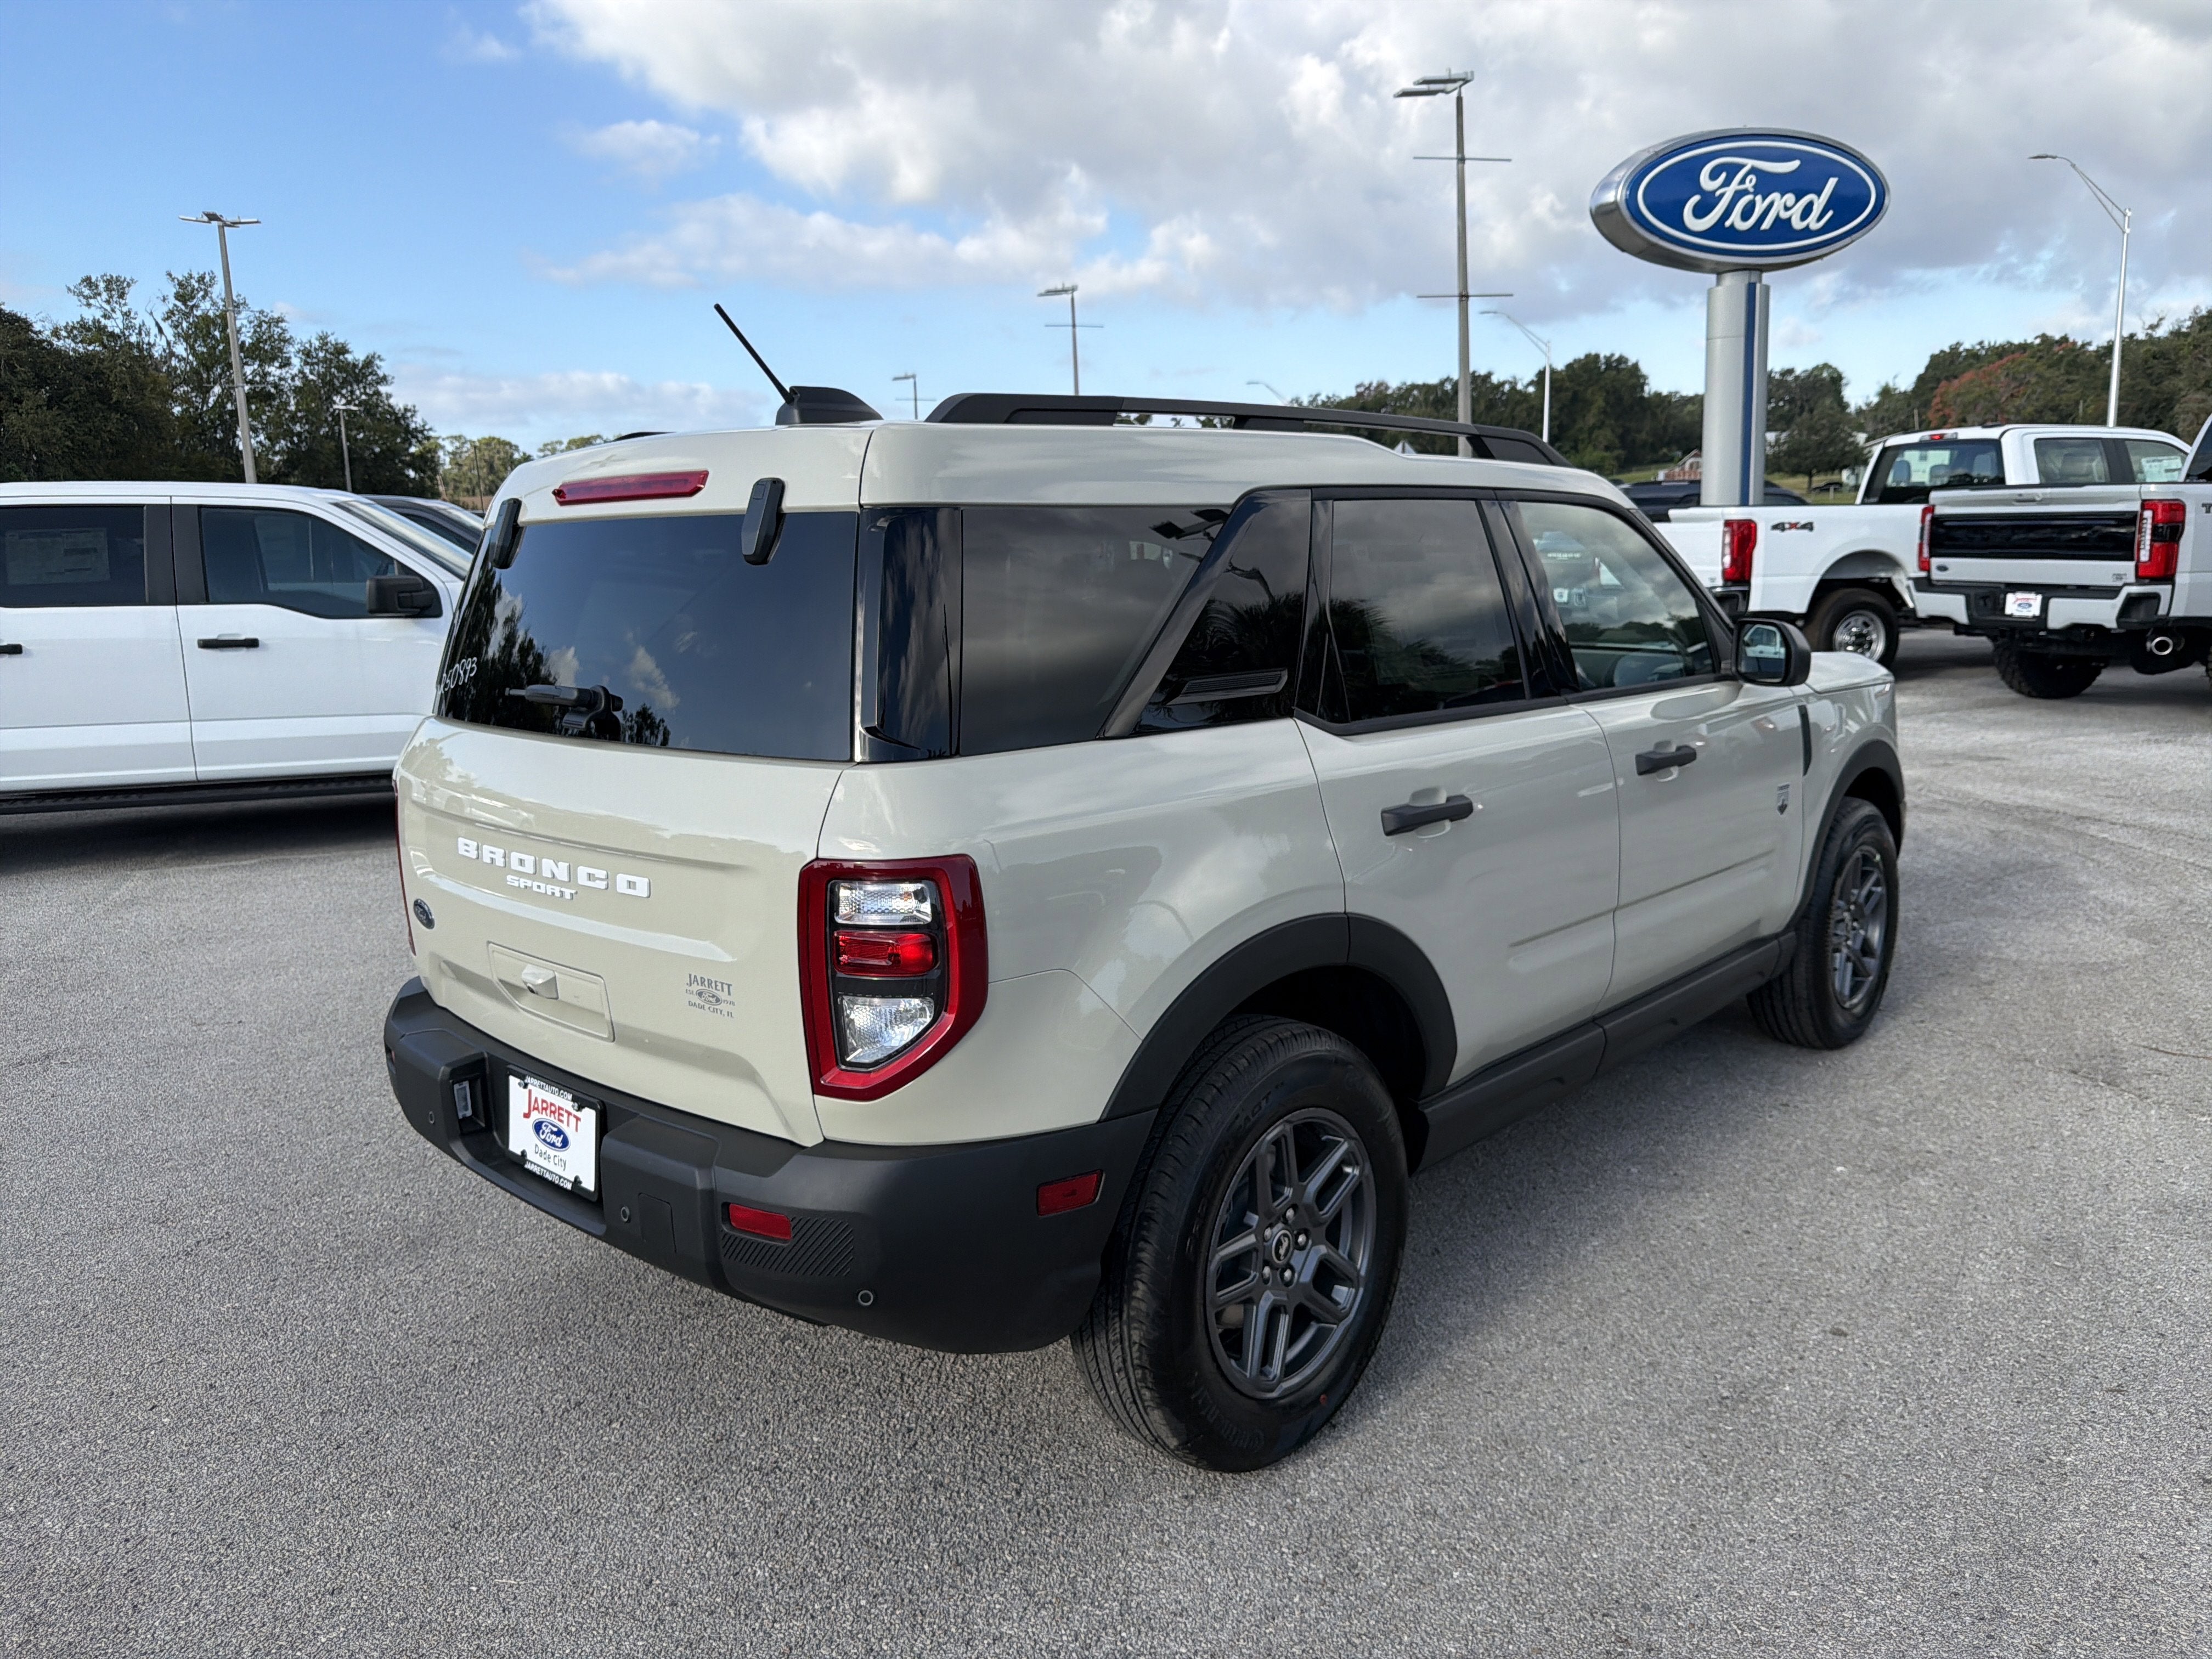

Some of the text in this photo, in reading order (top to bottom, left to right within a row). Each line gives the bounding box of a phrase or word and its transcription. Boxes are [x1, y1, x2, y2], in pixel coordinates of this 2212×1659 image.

[1683, 157, 1838, 232] Ford
[458, 837, 651, 899] BRONCO
[506, 874, 578, 900] SPORT
[686, 973, 732, 996] JARRETT
[689, 1001, 706, 1011] DADE
[524, 1075, 573, 1102] JARRETTAUTO.COM
[523, 1088, 582, 1133] JARRETT
[539, 1121, 563, 1148] Ford
[534, 1143, 567, 1172] Dade City
[524, 1161, 573, 1191] JARRETTAUTO.COM
